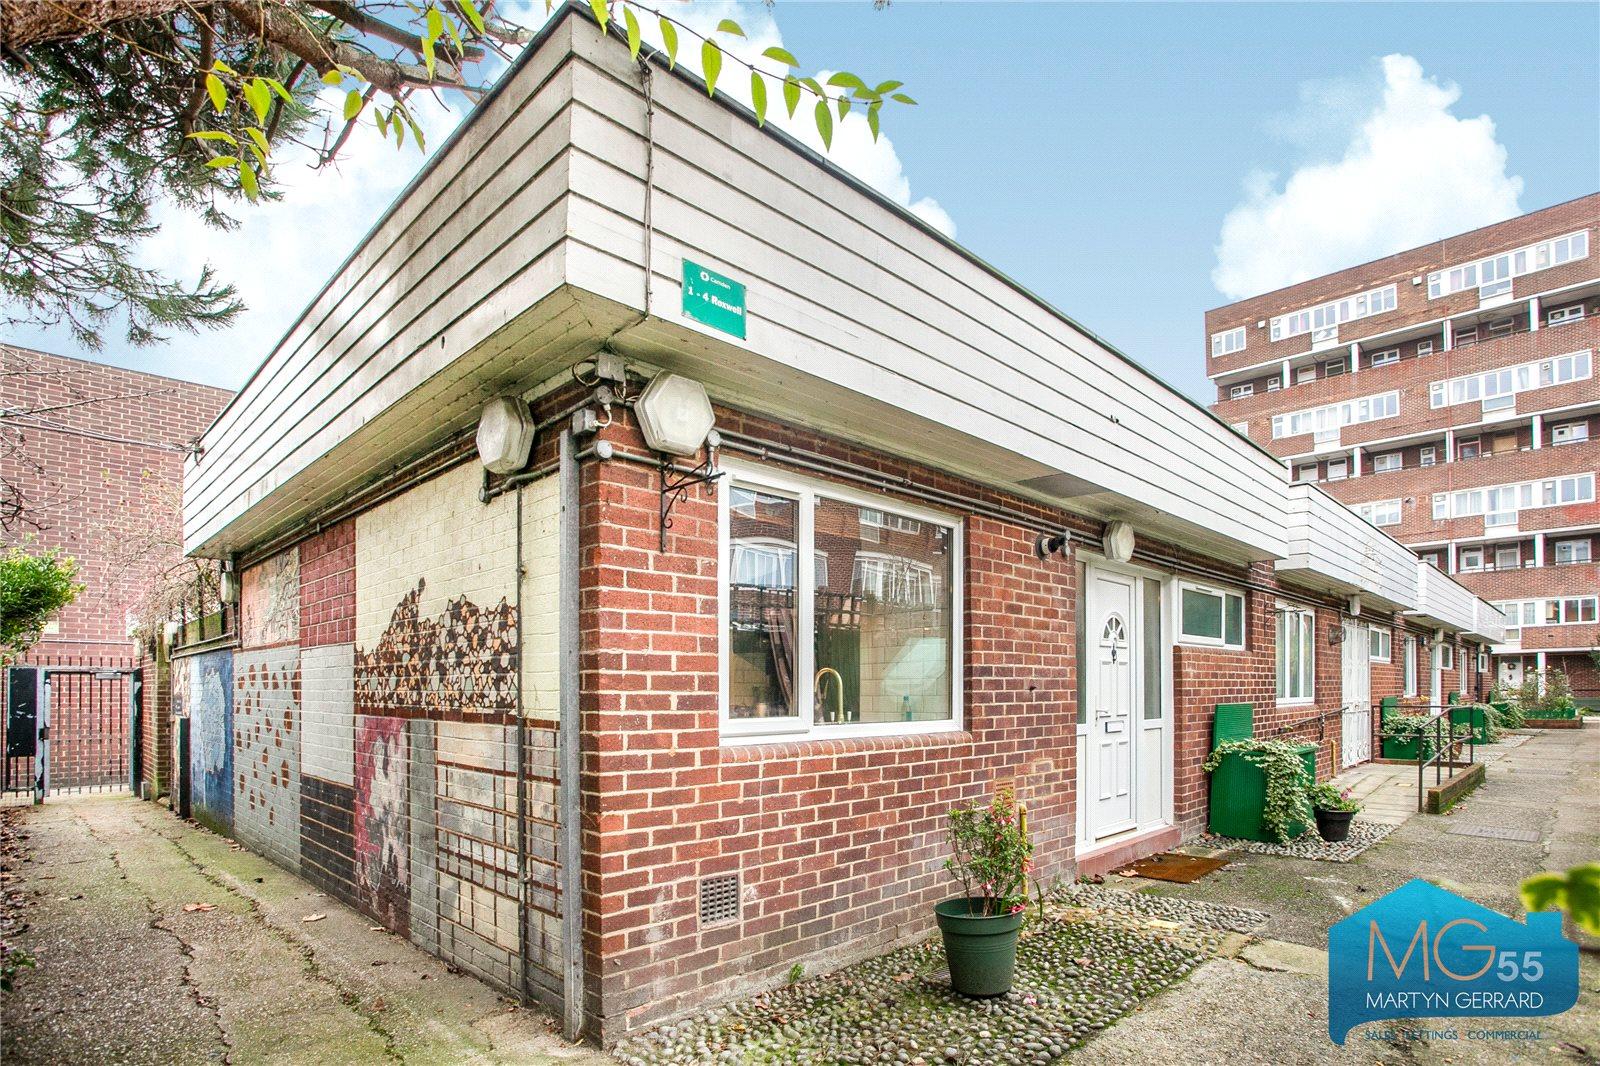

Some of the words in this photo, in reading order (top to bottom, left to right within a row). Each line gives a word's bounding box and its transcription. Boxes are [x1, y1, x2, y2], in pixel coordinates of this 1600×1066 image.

[710, 277, 731, 290] Camden
[688, 286, 694, 295] 1
[703, 292, 709, 302] 4
[711, 295, 742, 316] Roxwell
